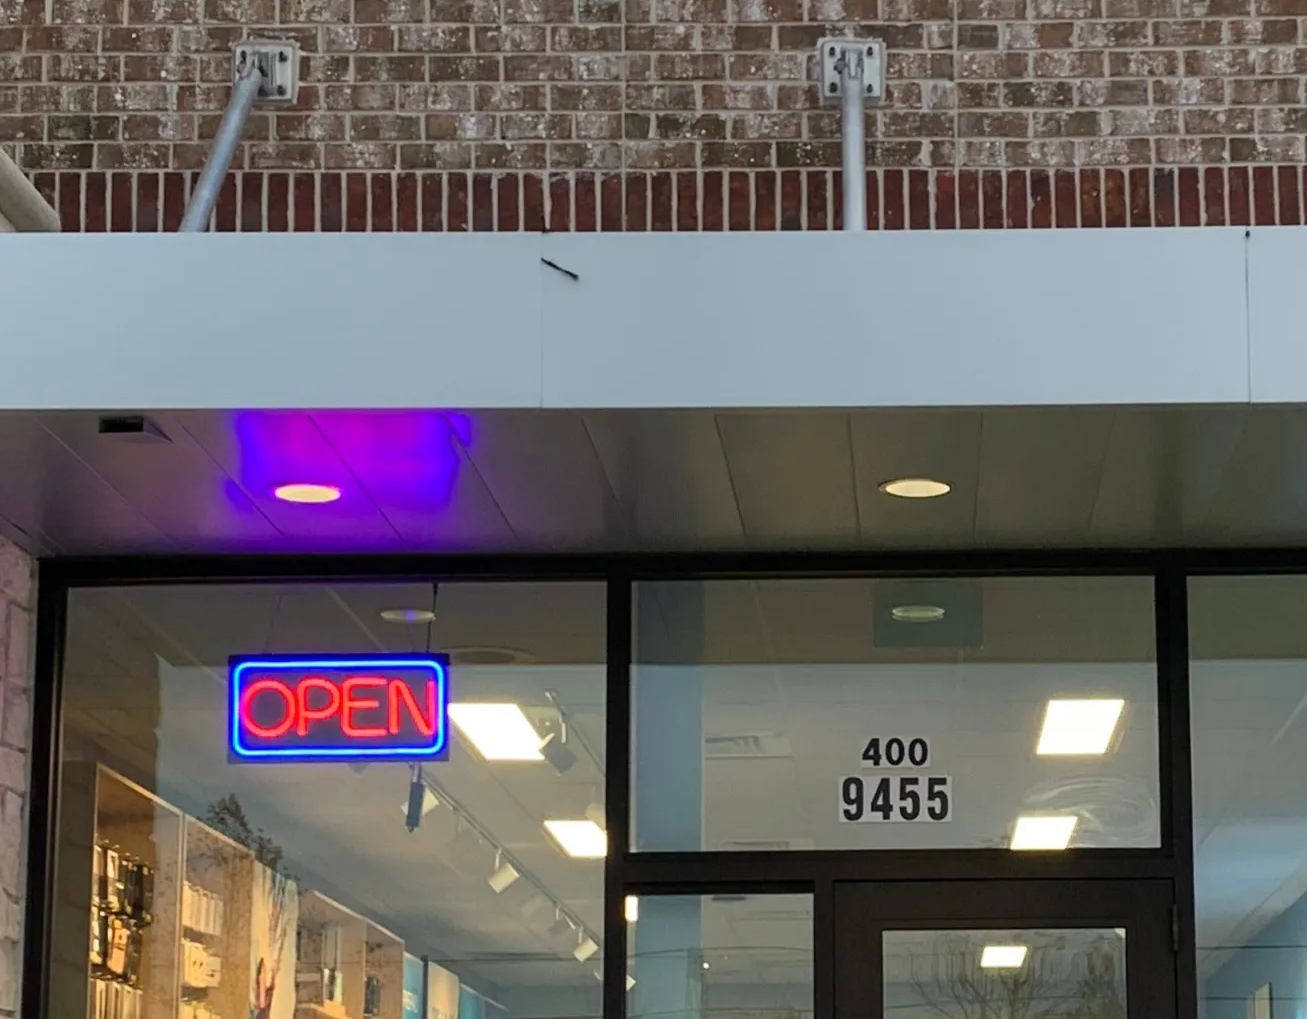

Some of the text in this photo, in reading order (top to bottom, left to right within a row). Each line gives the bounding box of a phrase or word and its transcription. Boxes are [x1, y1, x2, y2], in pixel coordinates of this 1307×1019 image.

[240, 676, 437, 738] OPEN
[861, 737, 929, 767] 400
[841, 776, 950, 821] 9455
